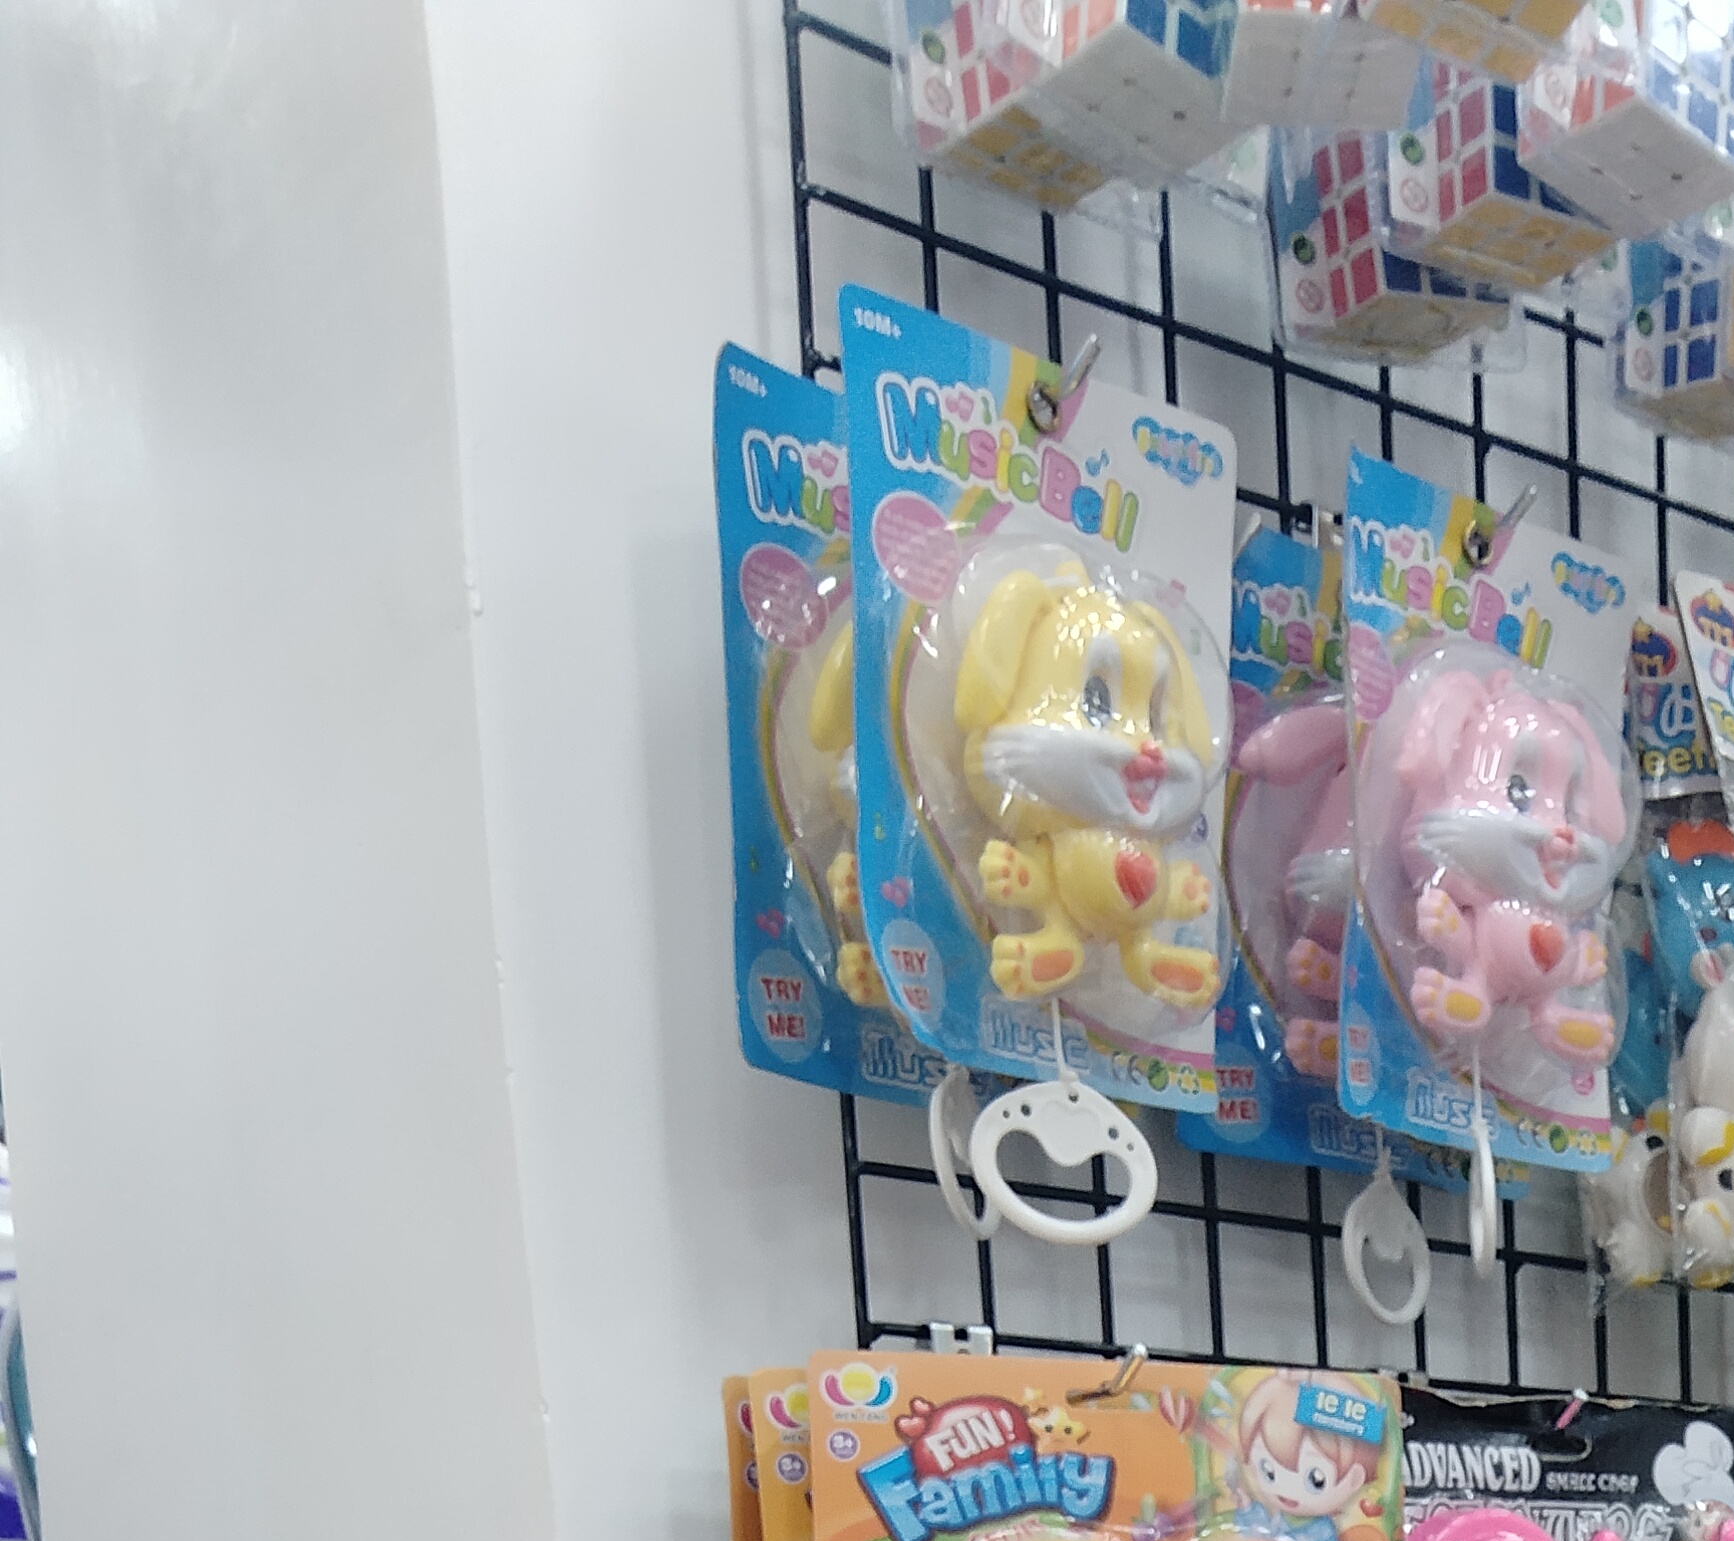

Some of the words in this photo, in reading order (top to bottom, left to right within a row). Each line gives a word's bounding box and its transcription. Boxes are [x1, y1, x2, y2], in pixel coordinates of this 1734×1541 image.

[742, 430, 848, 535] Mus
[890, 951, 929, 975] TRY
[760, 977, 803, 1001] TRY
[767, 1012, 807, 1038] ME!
[1215, 1066, 1256, 1090] TRY
[1216, 1099, 1258, 1123] ME!
[923, 1407, 1016, 1473] FUN!
[1401, 1440, 1542, 1493] ADVANCED
